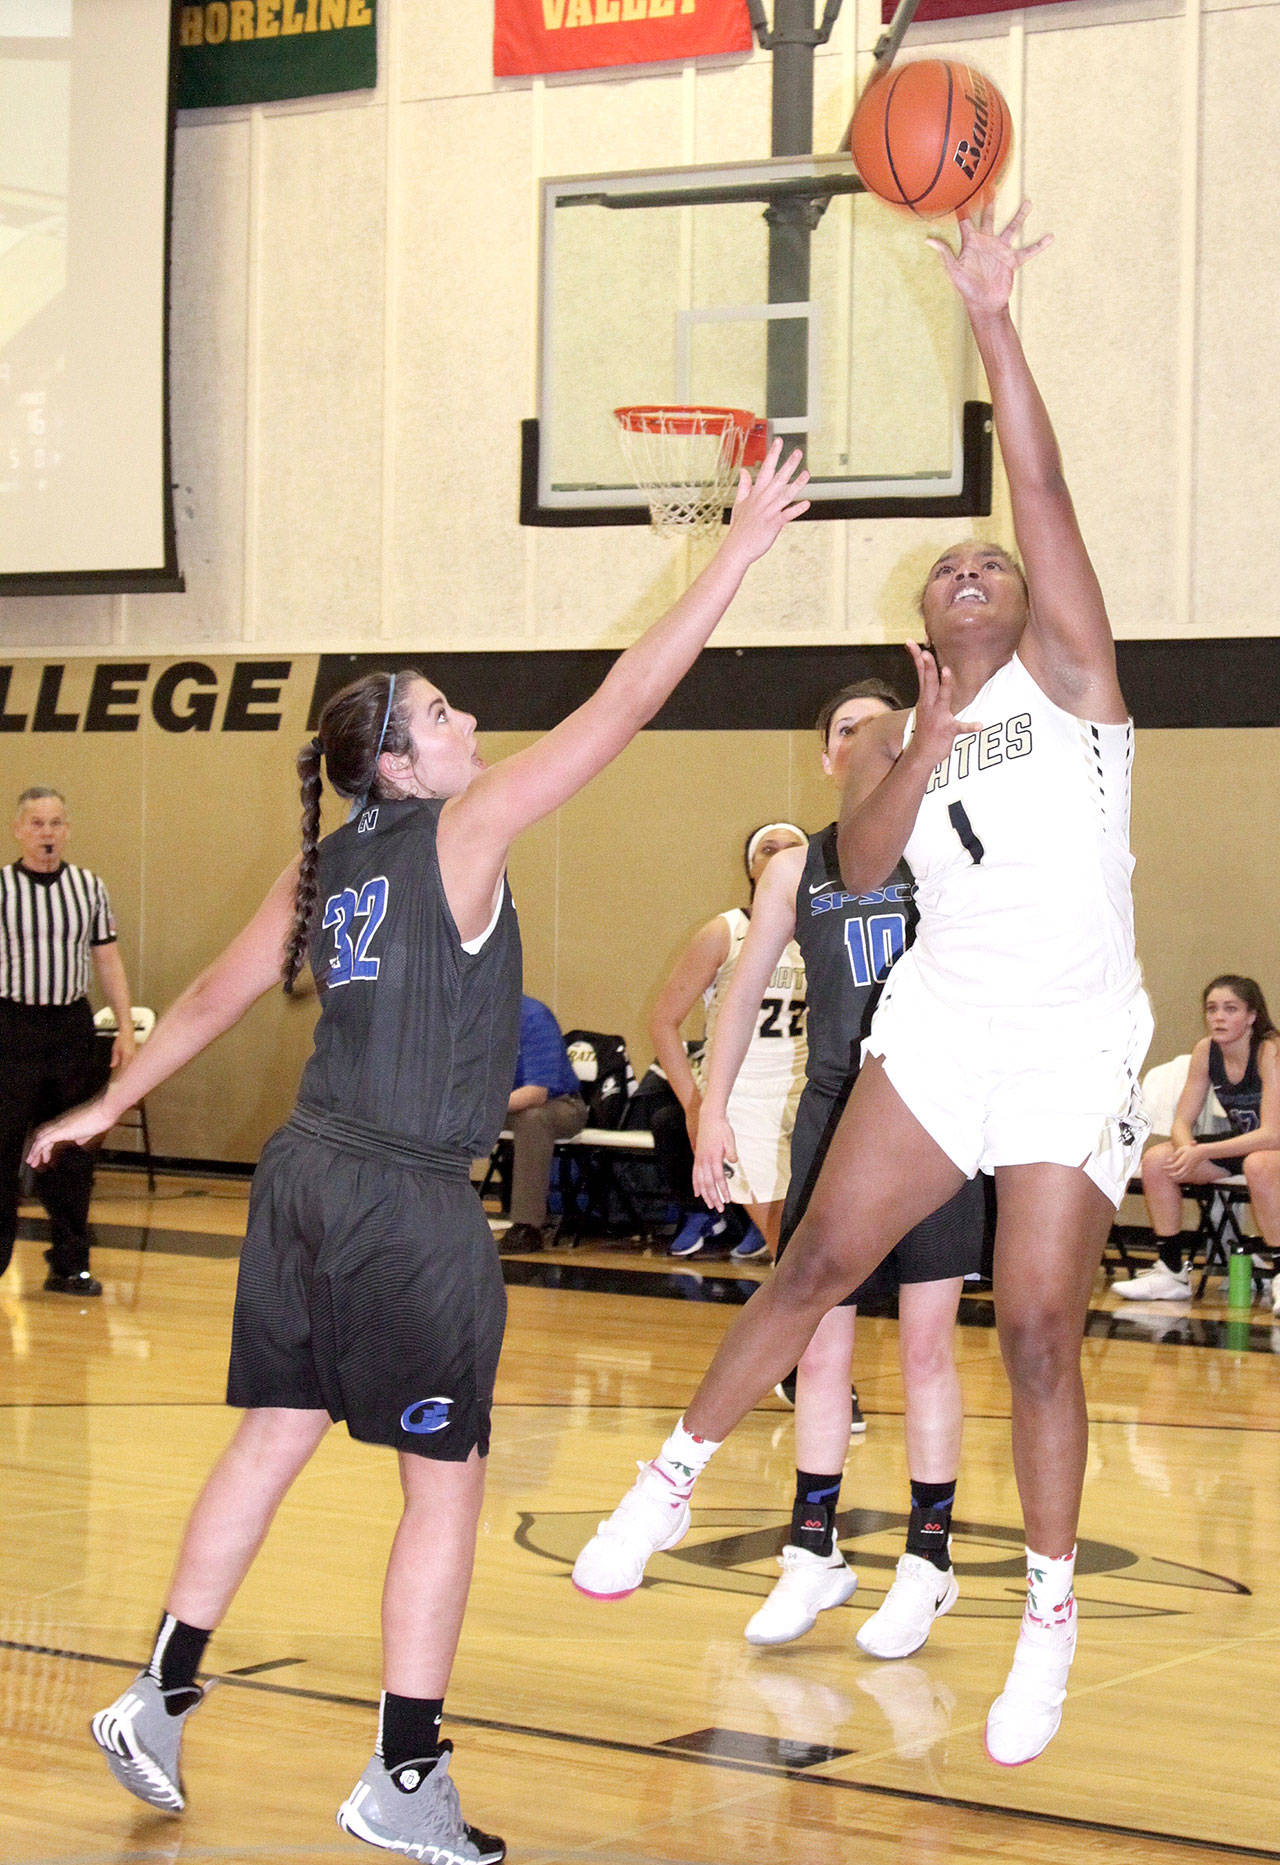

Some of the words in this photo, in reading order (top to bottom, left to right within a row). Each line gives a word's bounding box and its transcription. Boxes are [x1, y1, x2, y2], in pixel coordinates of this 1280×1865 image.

[947, 797, 985, 867] 1
[322, 876, 389, 989] 32
[844, 913, 906, 987] 10
[759, 998, 807, 1038] 22
